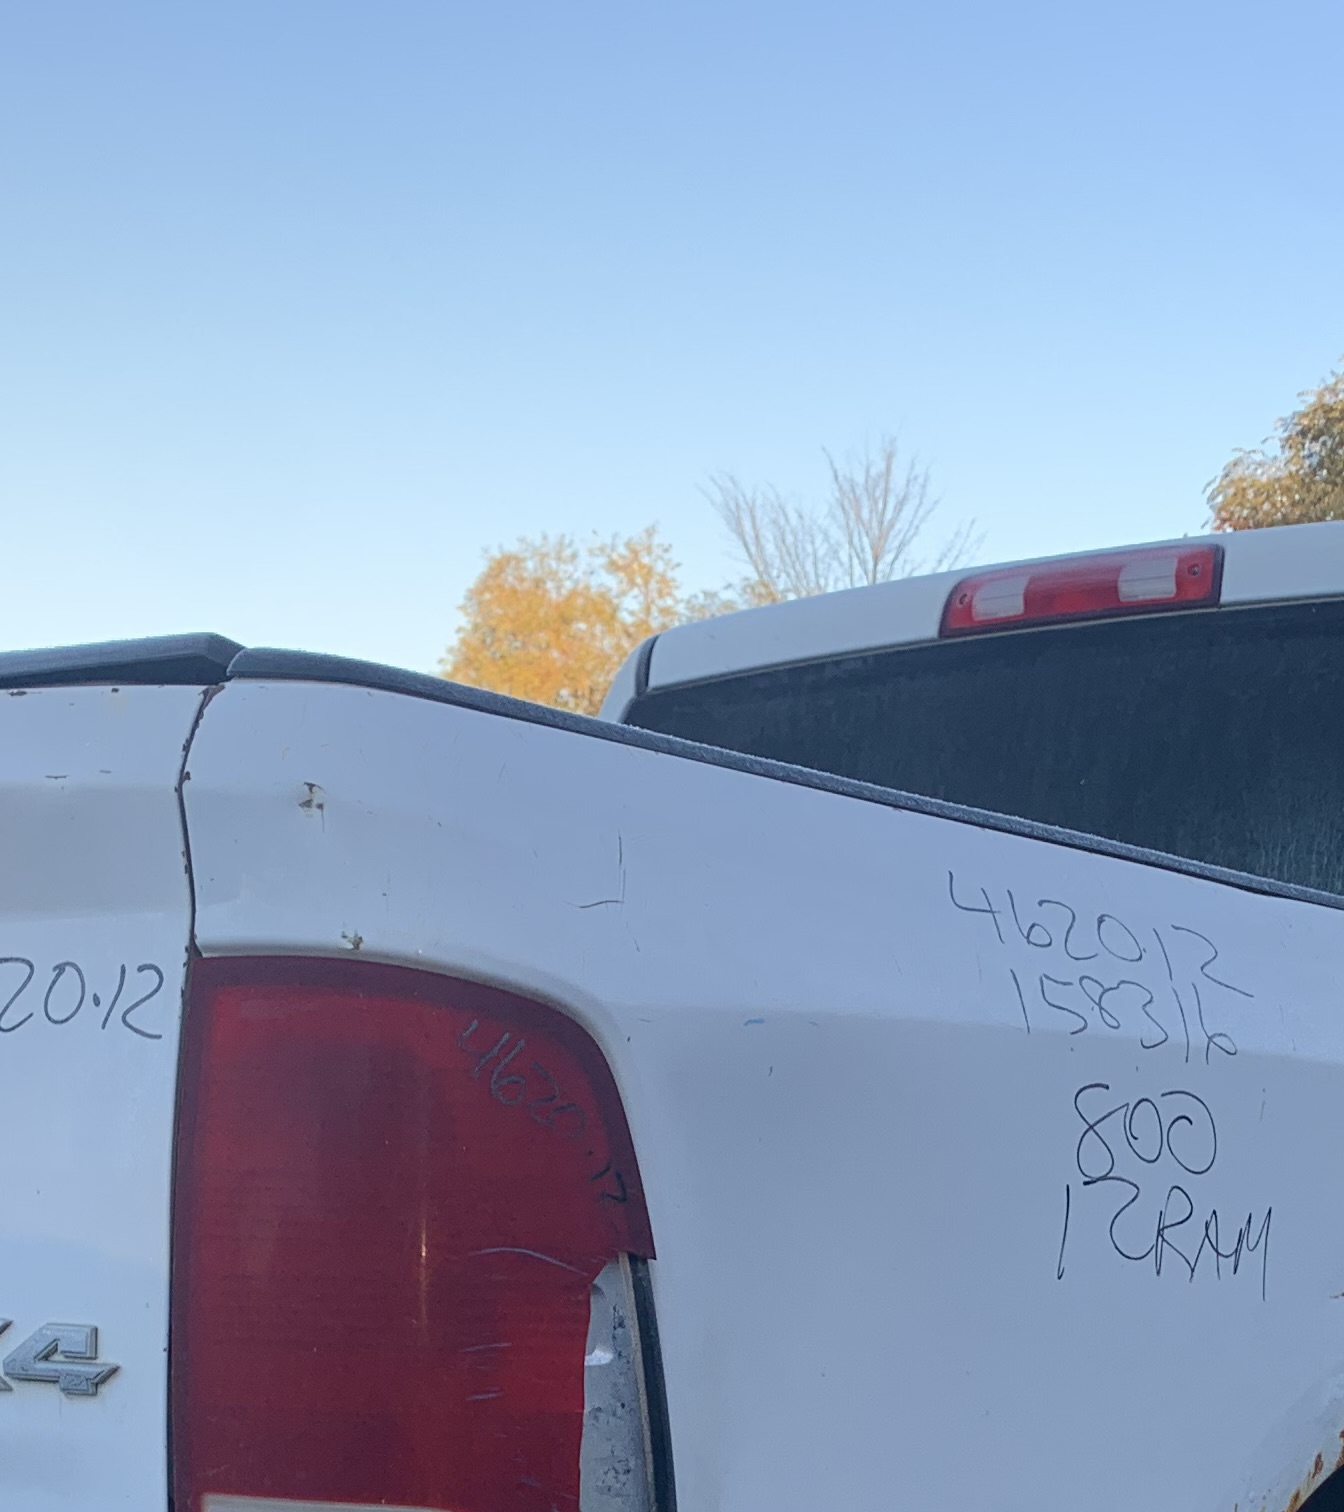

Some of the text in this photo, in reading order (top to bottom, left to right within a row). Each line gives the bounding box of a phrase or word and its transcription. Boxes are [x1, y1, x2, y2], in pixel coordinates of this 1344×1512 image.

[948, 869, 1255, 998] 4620.12
[1009, 968, 1238, 1066] 158316
[1073, 1082, 1218, 1181] 800
